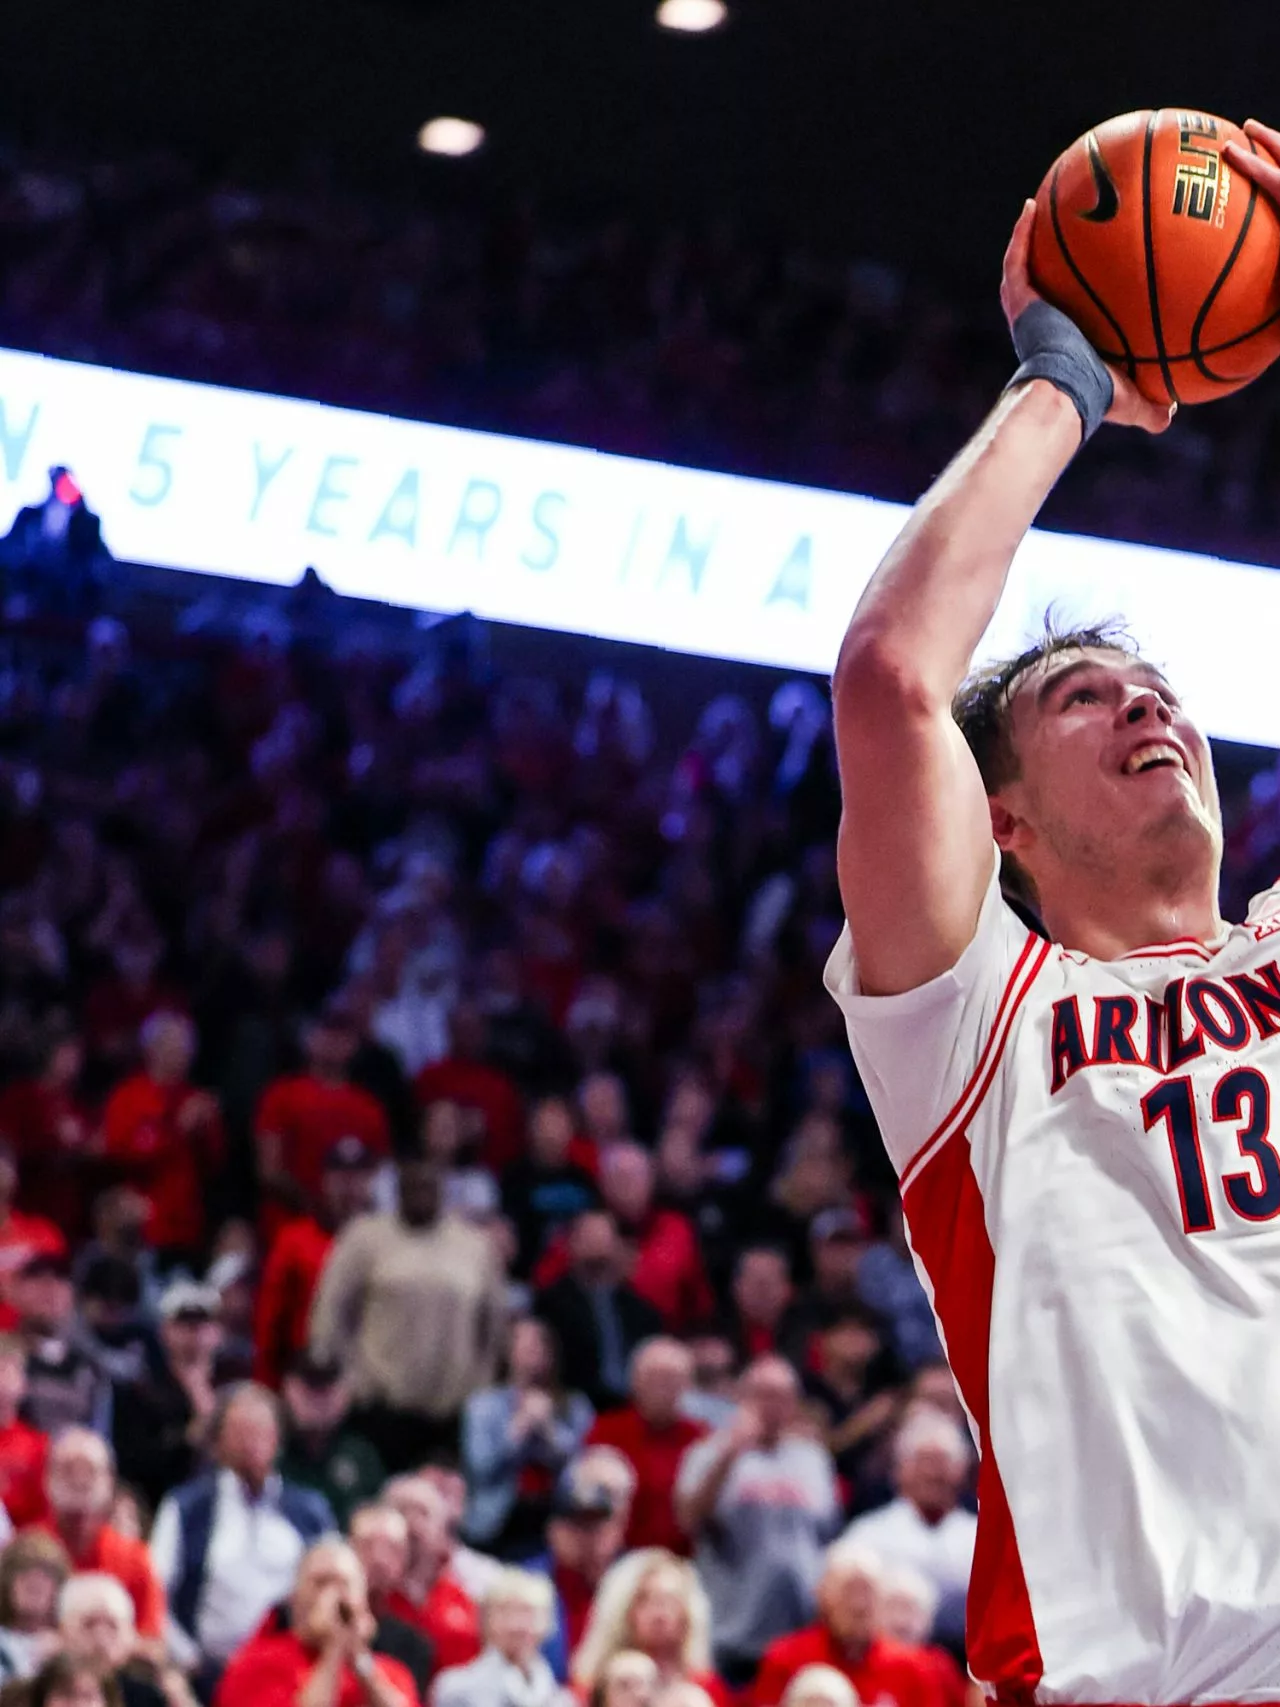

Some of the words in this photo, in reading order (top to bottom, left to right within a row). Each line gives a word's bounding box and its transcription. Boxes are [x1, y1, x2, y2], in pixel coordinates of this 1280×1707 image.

[127, 420, 183, 508] 5
[249, 439, 569, 573] YEARS
[618, 505, 722, 596] IN
[763, 533, 816, 612] A
